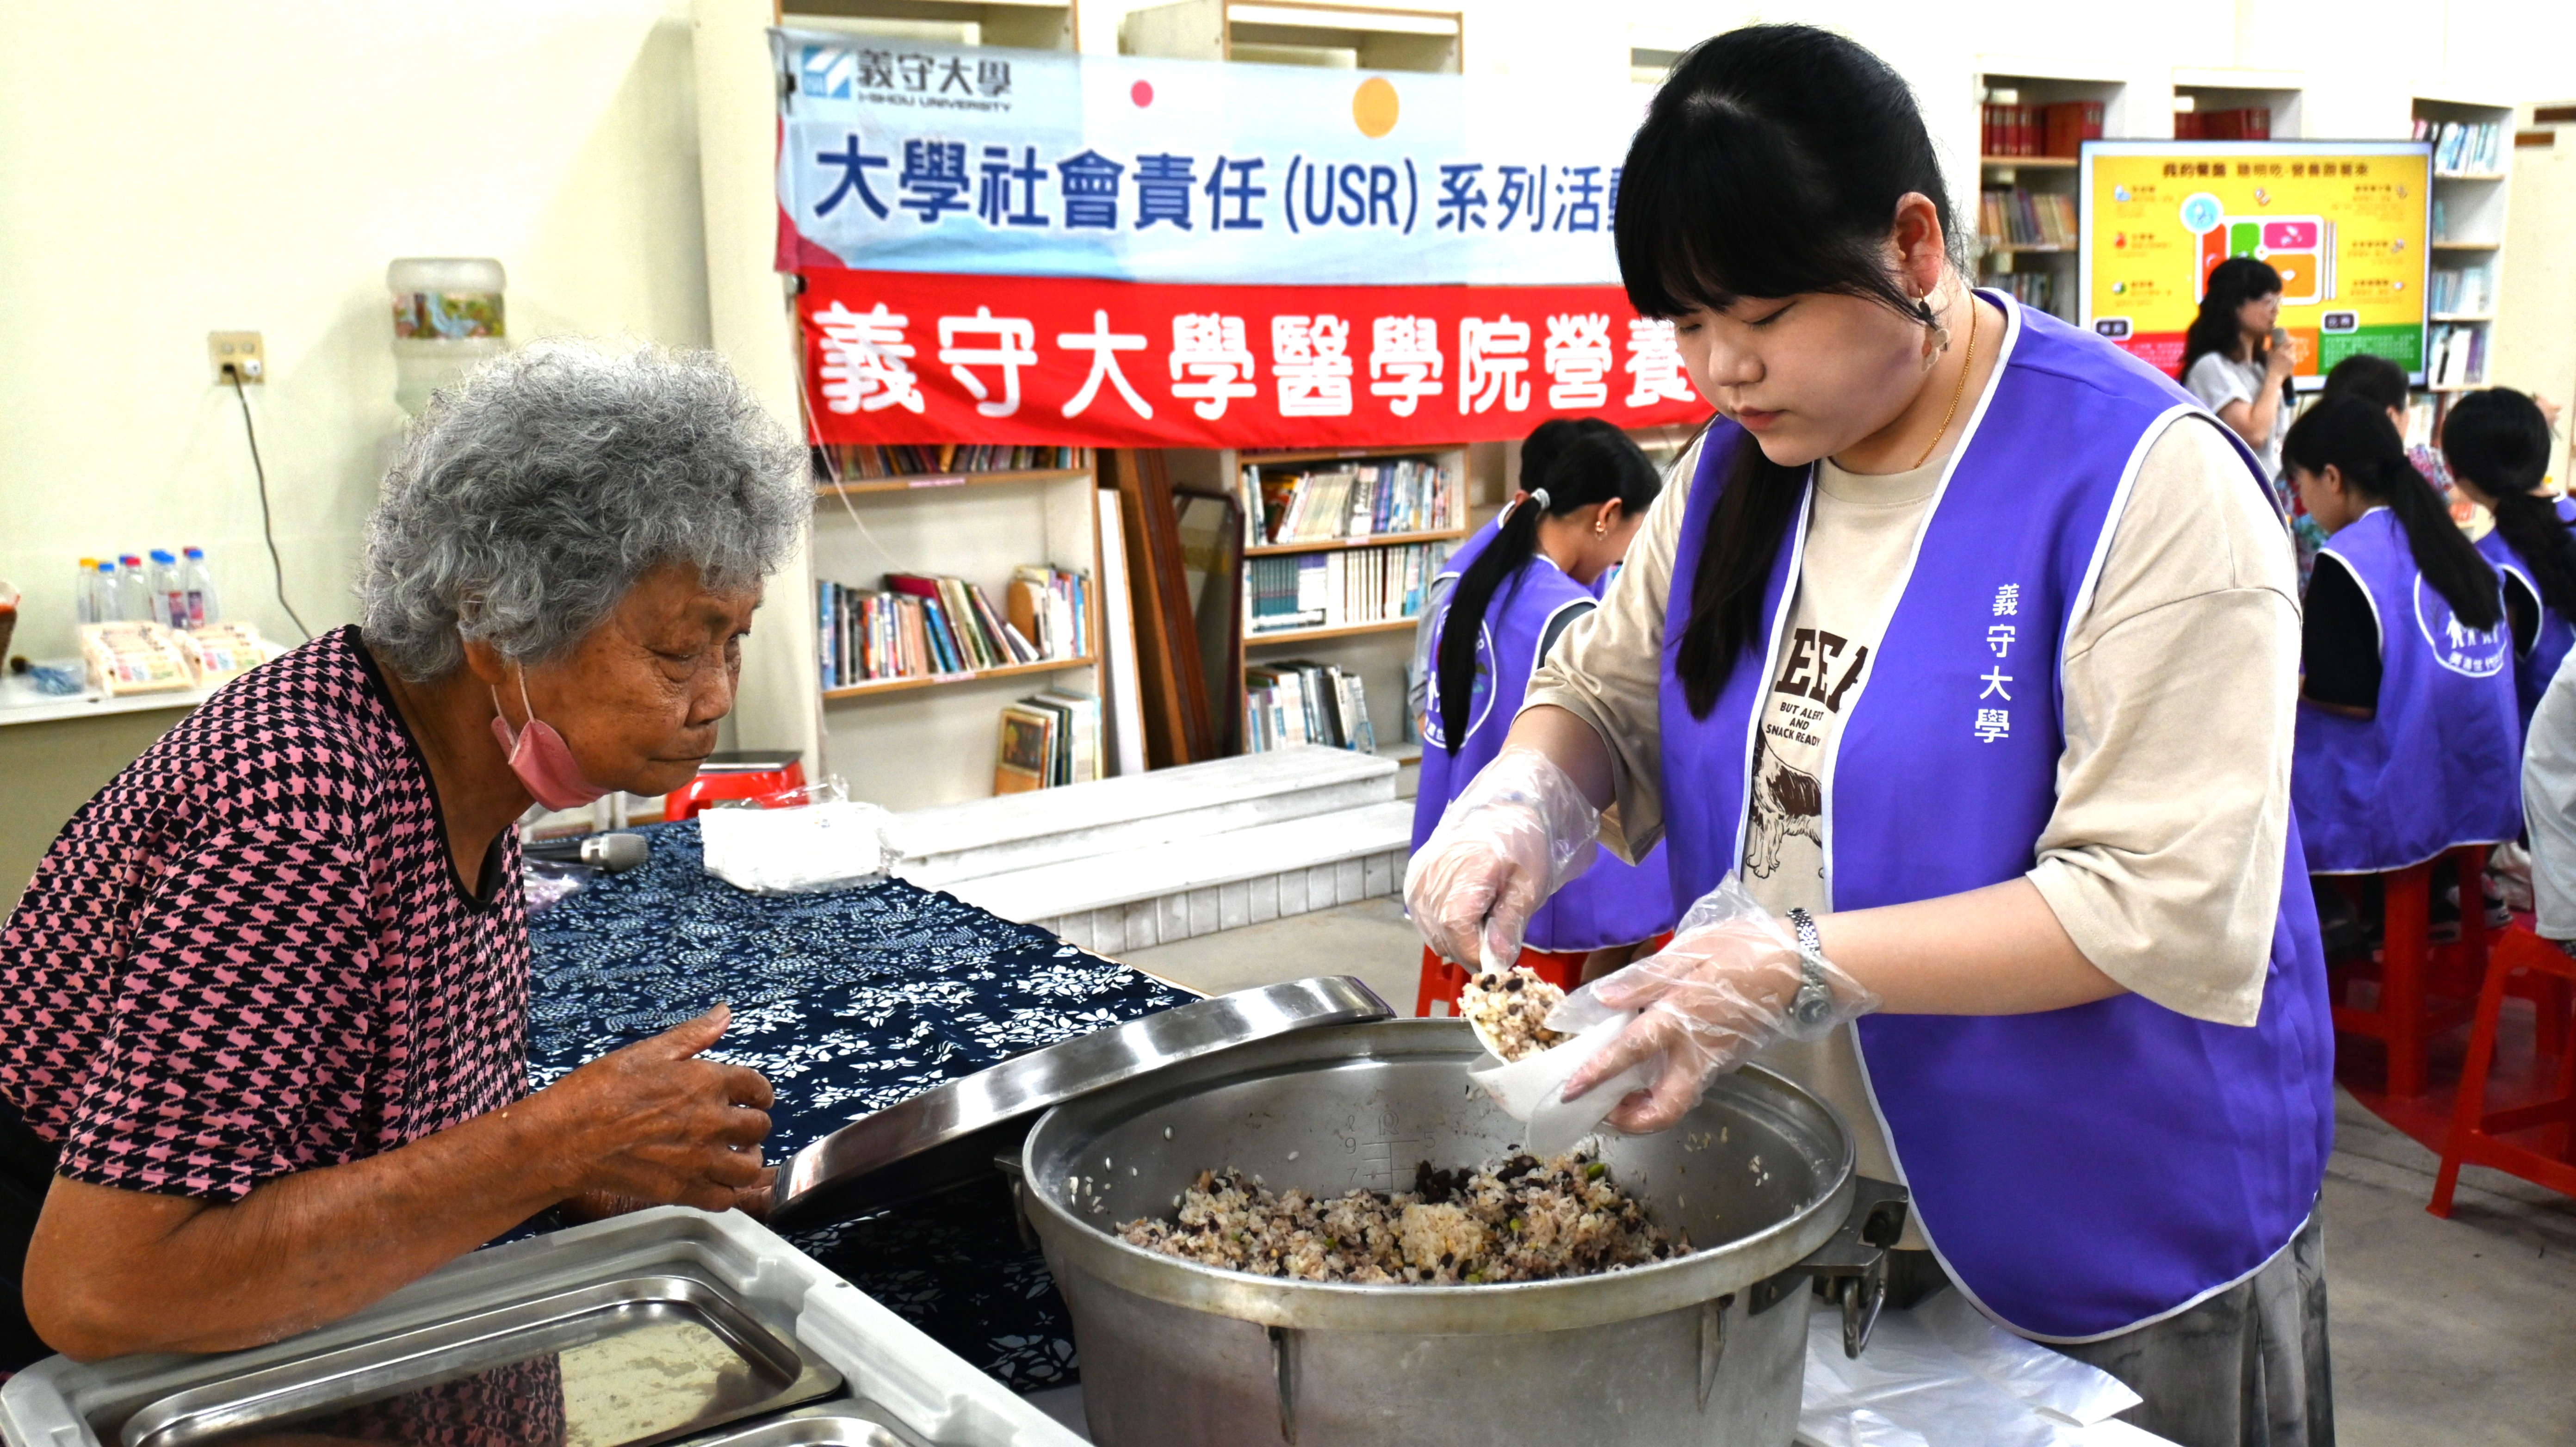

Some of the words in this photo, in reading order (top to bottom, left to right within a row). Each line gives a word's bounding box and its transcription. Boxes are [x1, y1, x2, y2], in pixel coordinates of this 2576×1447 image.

[857, 49, 1012, 97] 義守大學
[814, 133, 1622, 235] 大學社會責任(USR)系列活
[1974, 583, 2020, 743] 義守大學
[1780, 702, 1800, 714] BUT
[1800, 708, 1824, 721] ALERT
[1789, 717, 1810, 730] AND
[1765, 724, 1795, 740] SNACK
[1795, 732, 1821, 747] READY
[1344, 1137, 1356, 1155] 9
[1424, 1131, 1436, 1149] 5
[1347, 1168, 1358, 1183] 7
